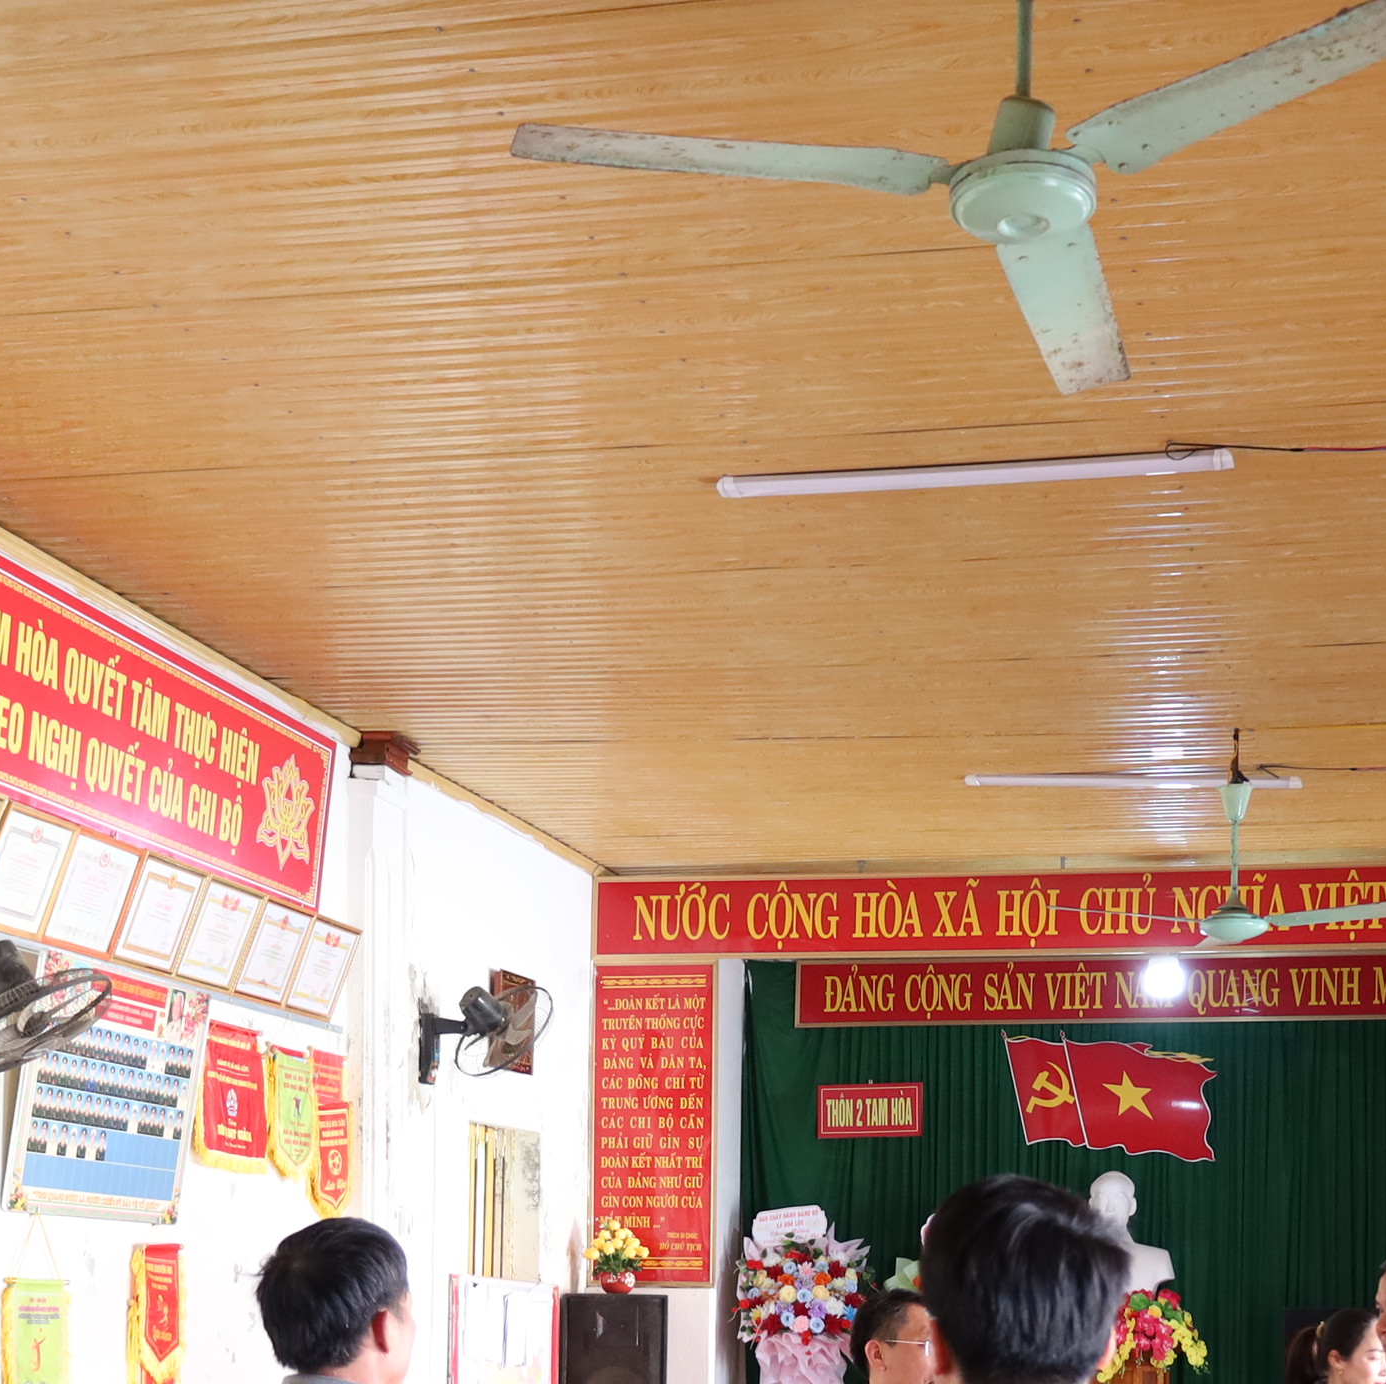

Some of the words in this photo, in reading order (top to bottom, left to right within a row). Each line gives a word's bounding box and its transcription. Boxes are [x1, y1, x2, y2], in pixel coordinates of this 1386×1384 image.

[15, 620, 58, 688] HÒA
[64, 648, 127, 719] QUYẾT
[131, 676, 171, 742] TÂM
[174, 701, 217, 771] THỰC
[220, 727, 259, 791] HIỆN
[29, 712, 81, 788] NGHỊ
[86, 738, 146, 803] QUYẾT
[149, 757, 183, 827] CỦA
[188, 784, 216, 839] CHI
[220, 797, 243, 855] BỘ
[633, 882, 730, 941] NƯỚC
[747, 880, 839, 950] CỘNG
[852, 880, 923, 938] HÒA
[932, 878, 982, 937] XÃ
[995, 877, 1060, 948] HỘI
[1080, 873, 1156, 935] CHỦ
[645, 993, 665, 1010] KẾT
[668, 994, 680, 1010] LÀ
[684, 993, 706, 1012] MỘT
[823, 964, 895, 1012] ĐẢNG
[905, 964, 972, 1020] CỘNG
[984, 961, 1035, 1011] SẢN
[1044, 962, 1107, 1018] VIỆT
[1188, 968, 1280, 1015] QUANG
[1289, 967, 1361, 1007] VINH
[601, 1096, 639, 1109] TRUNG
[643, 1095, 673, 1109] ƯƠNG
[680, 1093, 704, 1109] ĐẾN
[826, 1092, 853, 1127] THÔN
[856, 1098, 863, 1127] 2
[865, 1098, 888, 1126] TAM
[891, 1090, 913, 1126] HÒA
[630, 1117, 651, 1129] CHI
[622, 1196, 644, 1208] CON
